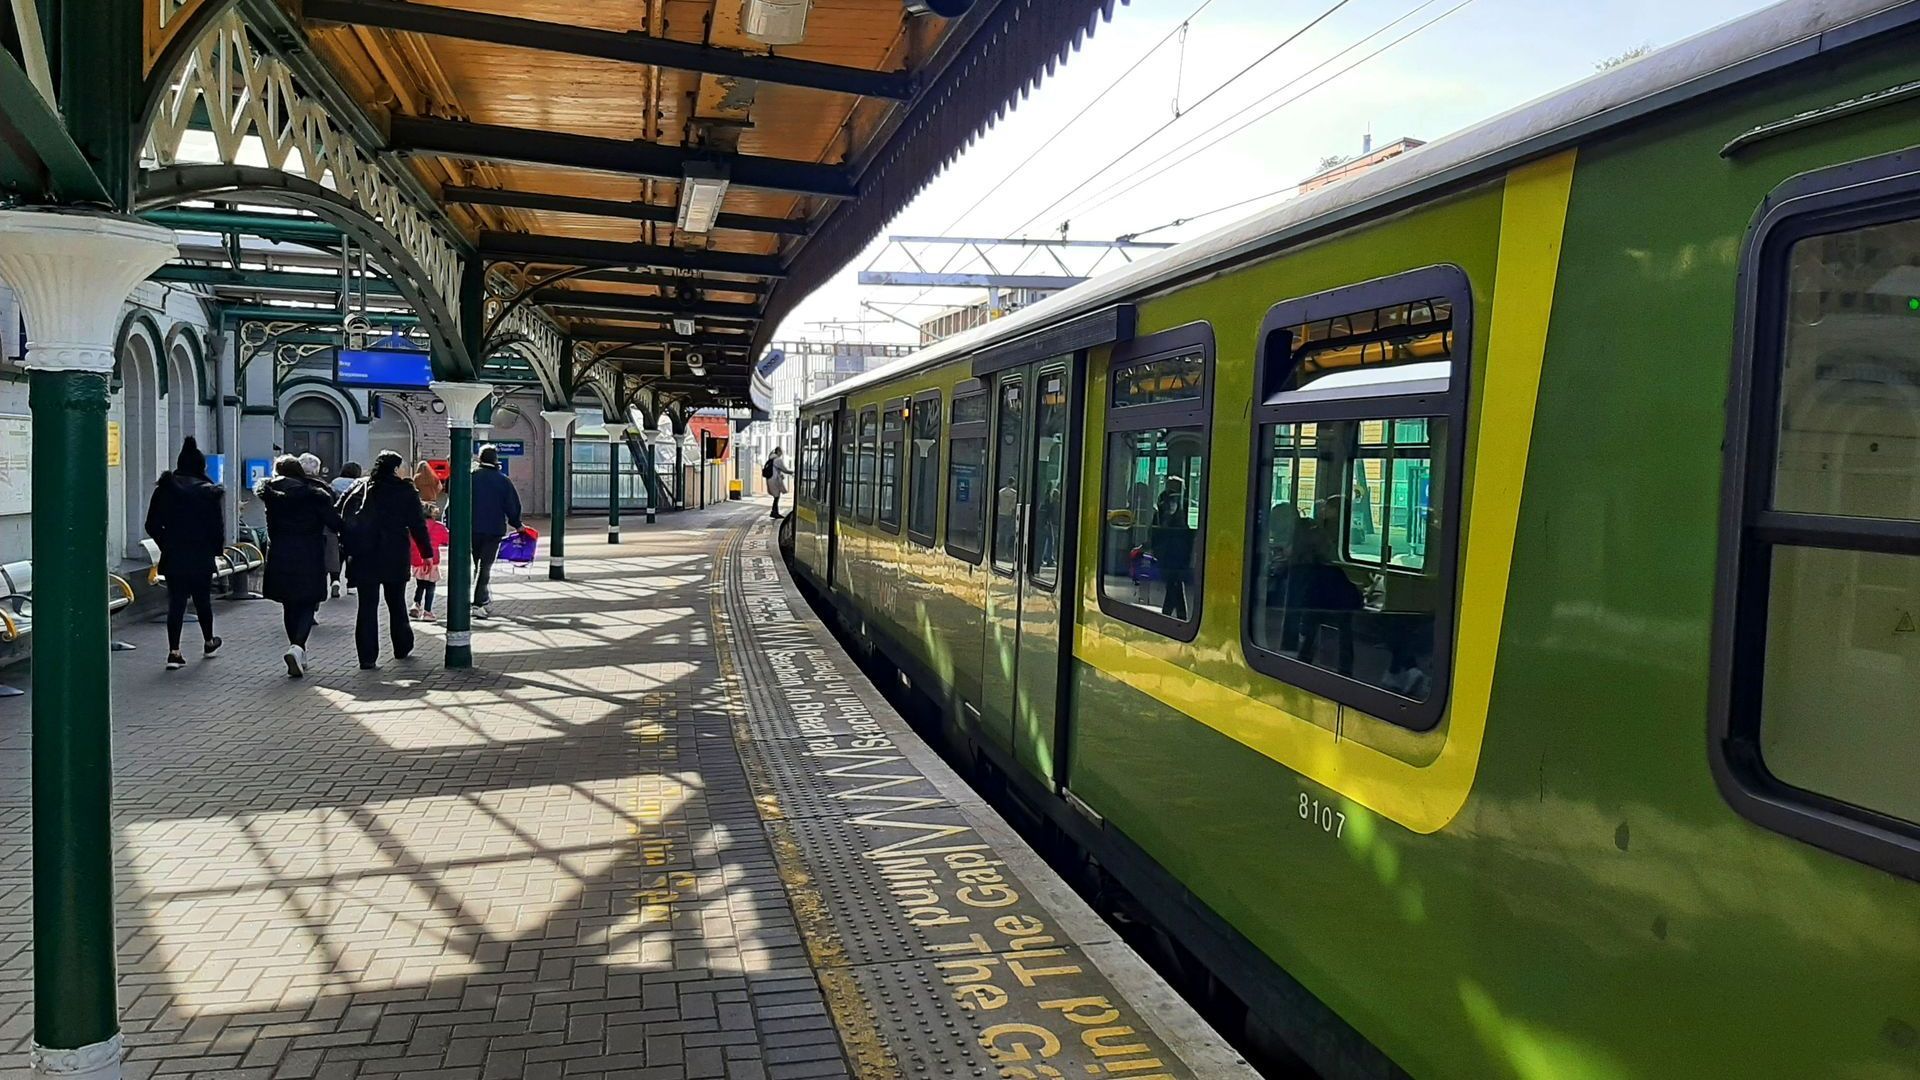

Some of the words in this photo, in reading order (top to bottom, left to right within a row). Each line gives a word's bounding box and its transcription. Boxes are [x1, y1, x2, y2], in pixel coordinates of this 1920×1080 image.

[784, 688, 816, 701] An
[821, 683, 855, 695] An
[1299, 793, 1345, 838] 8107
[944, 852, 1019, 908] Gap
[874, 857, 971, 926] Mind
[923, 933, 1009, 1010] The
[978, 1023, 1066, 1080] Ga
[994, 914, 1082, 988] The
